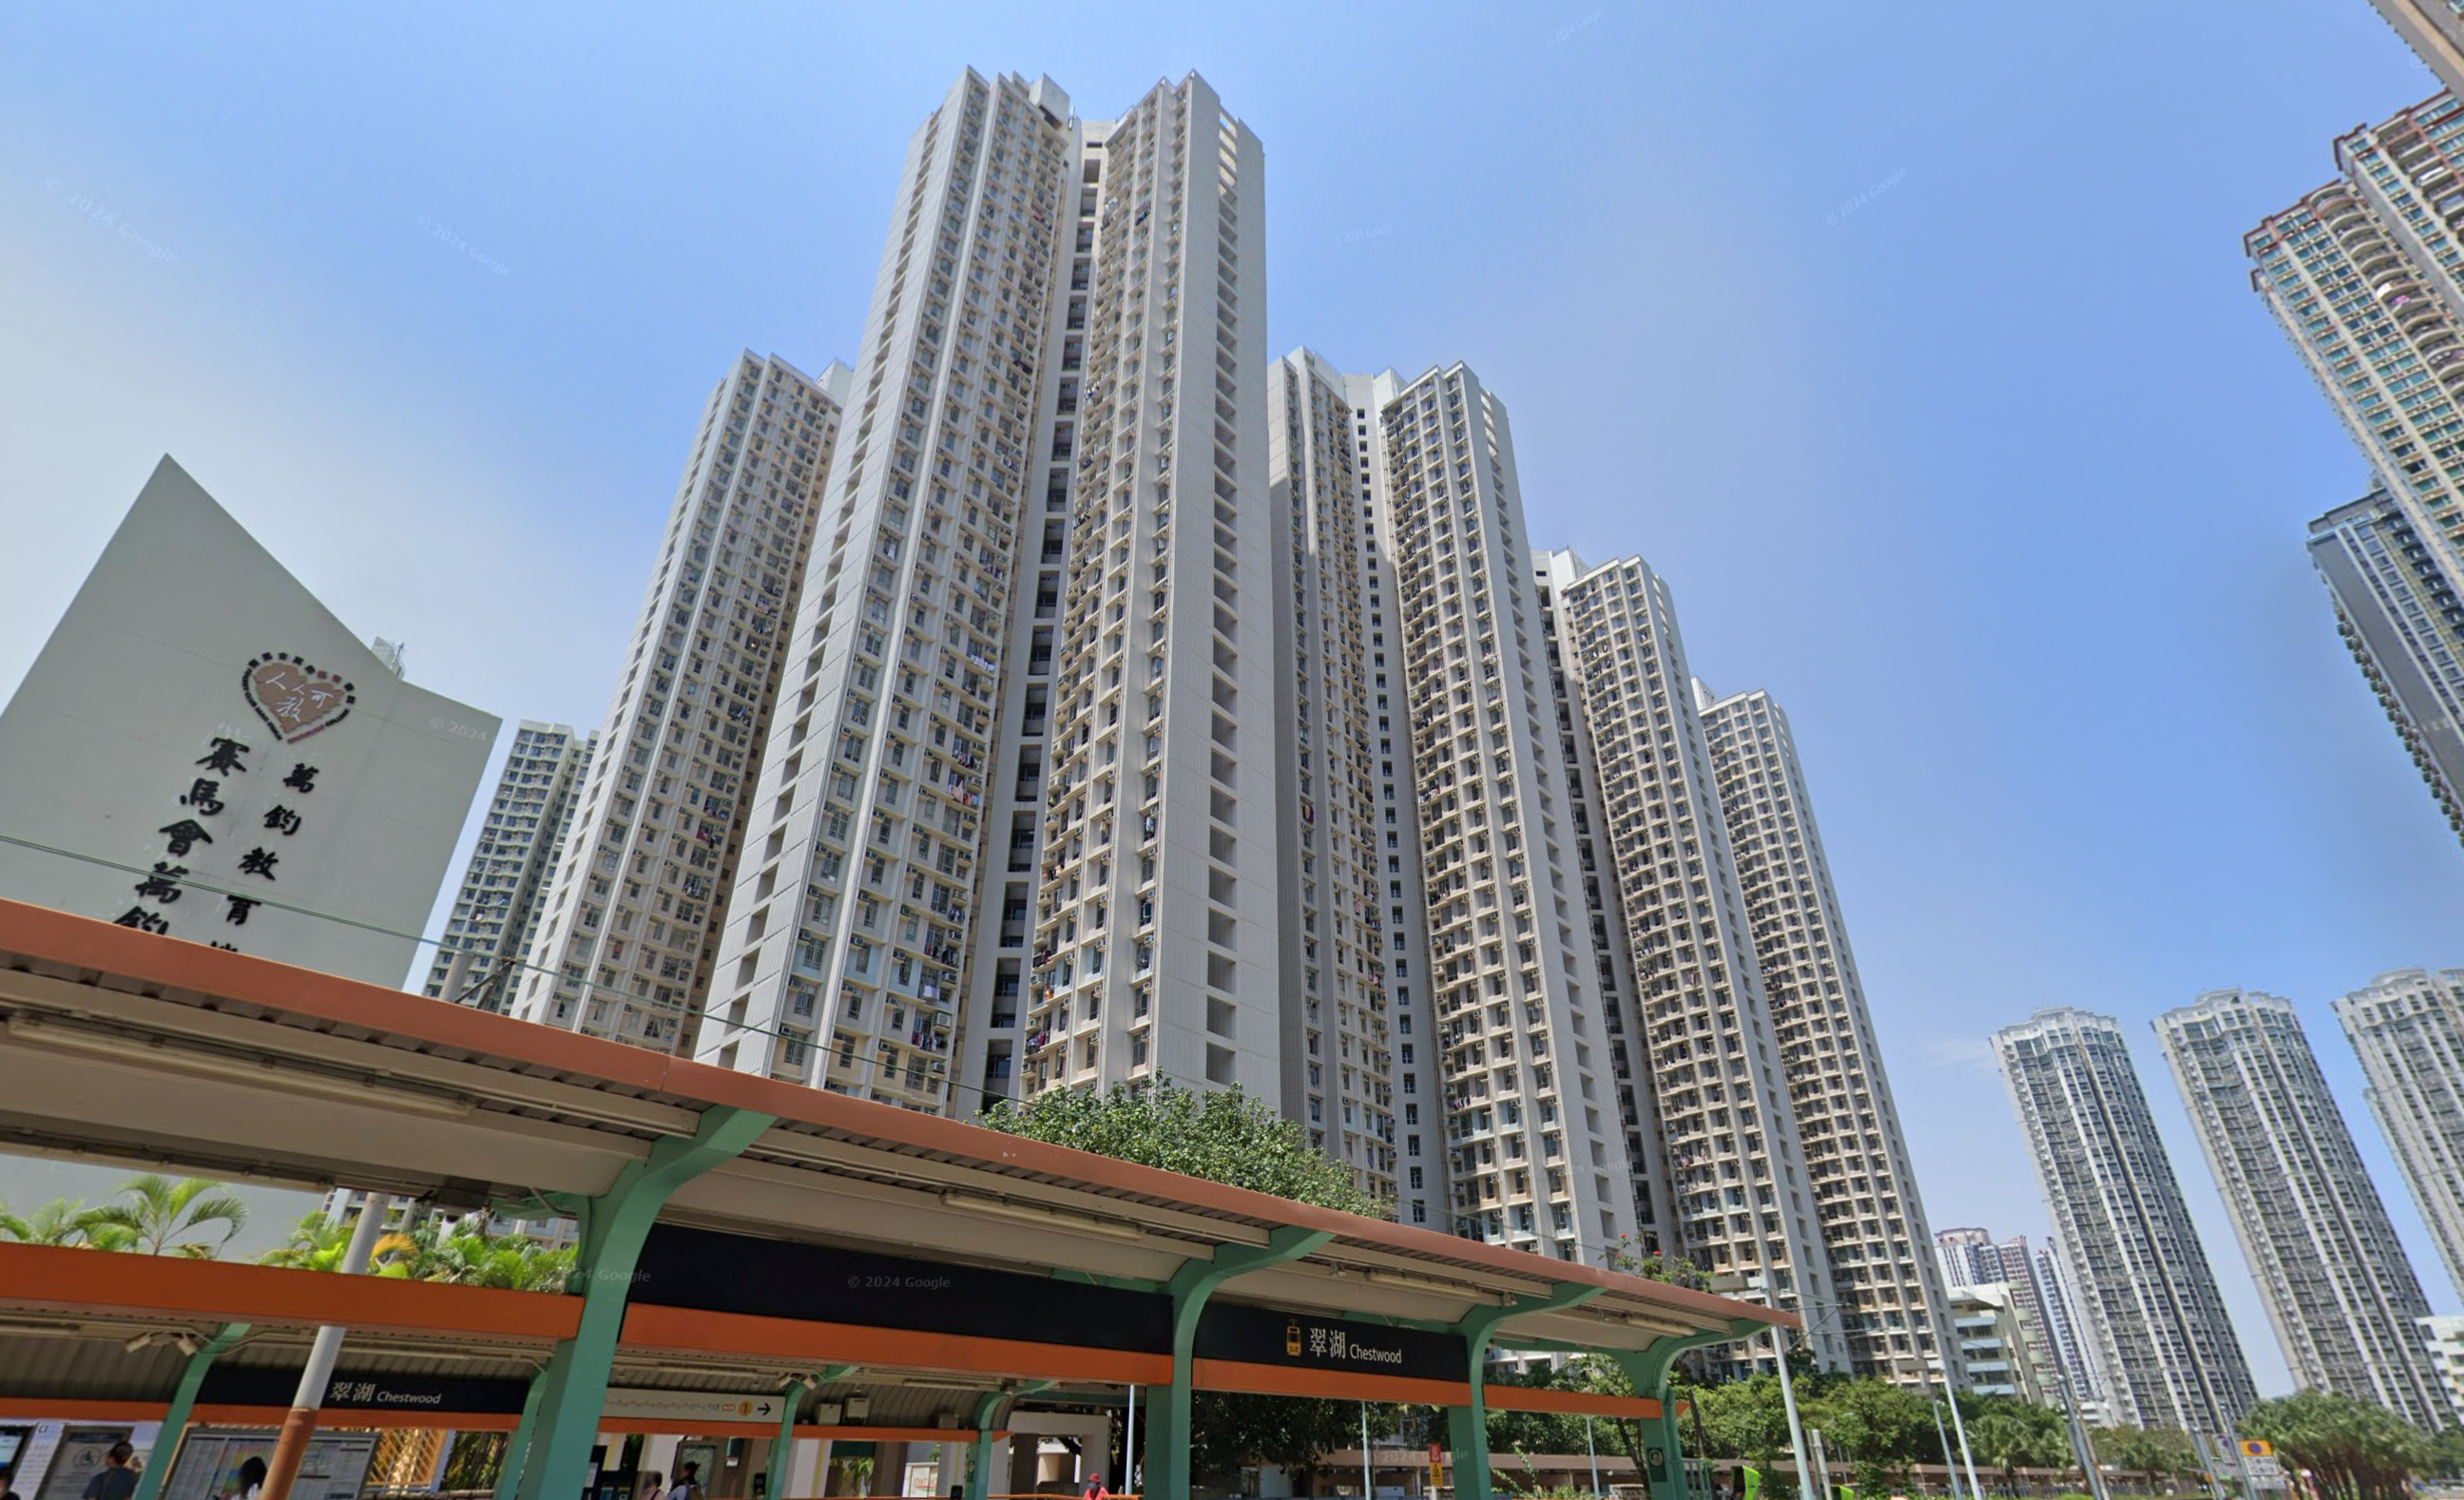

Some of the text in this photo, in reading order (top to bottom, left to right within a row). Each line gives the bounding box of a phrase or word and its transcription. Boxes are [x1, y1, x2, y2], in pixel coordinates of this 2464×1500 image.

[210, 762, 319, 952] 萬鈞教育
[1310, 1327, 1402, 1364] 翠湖 Chestwood
[329, 1382, 442, 1404] 翠湖 Chestwood
